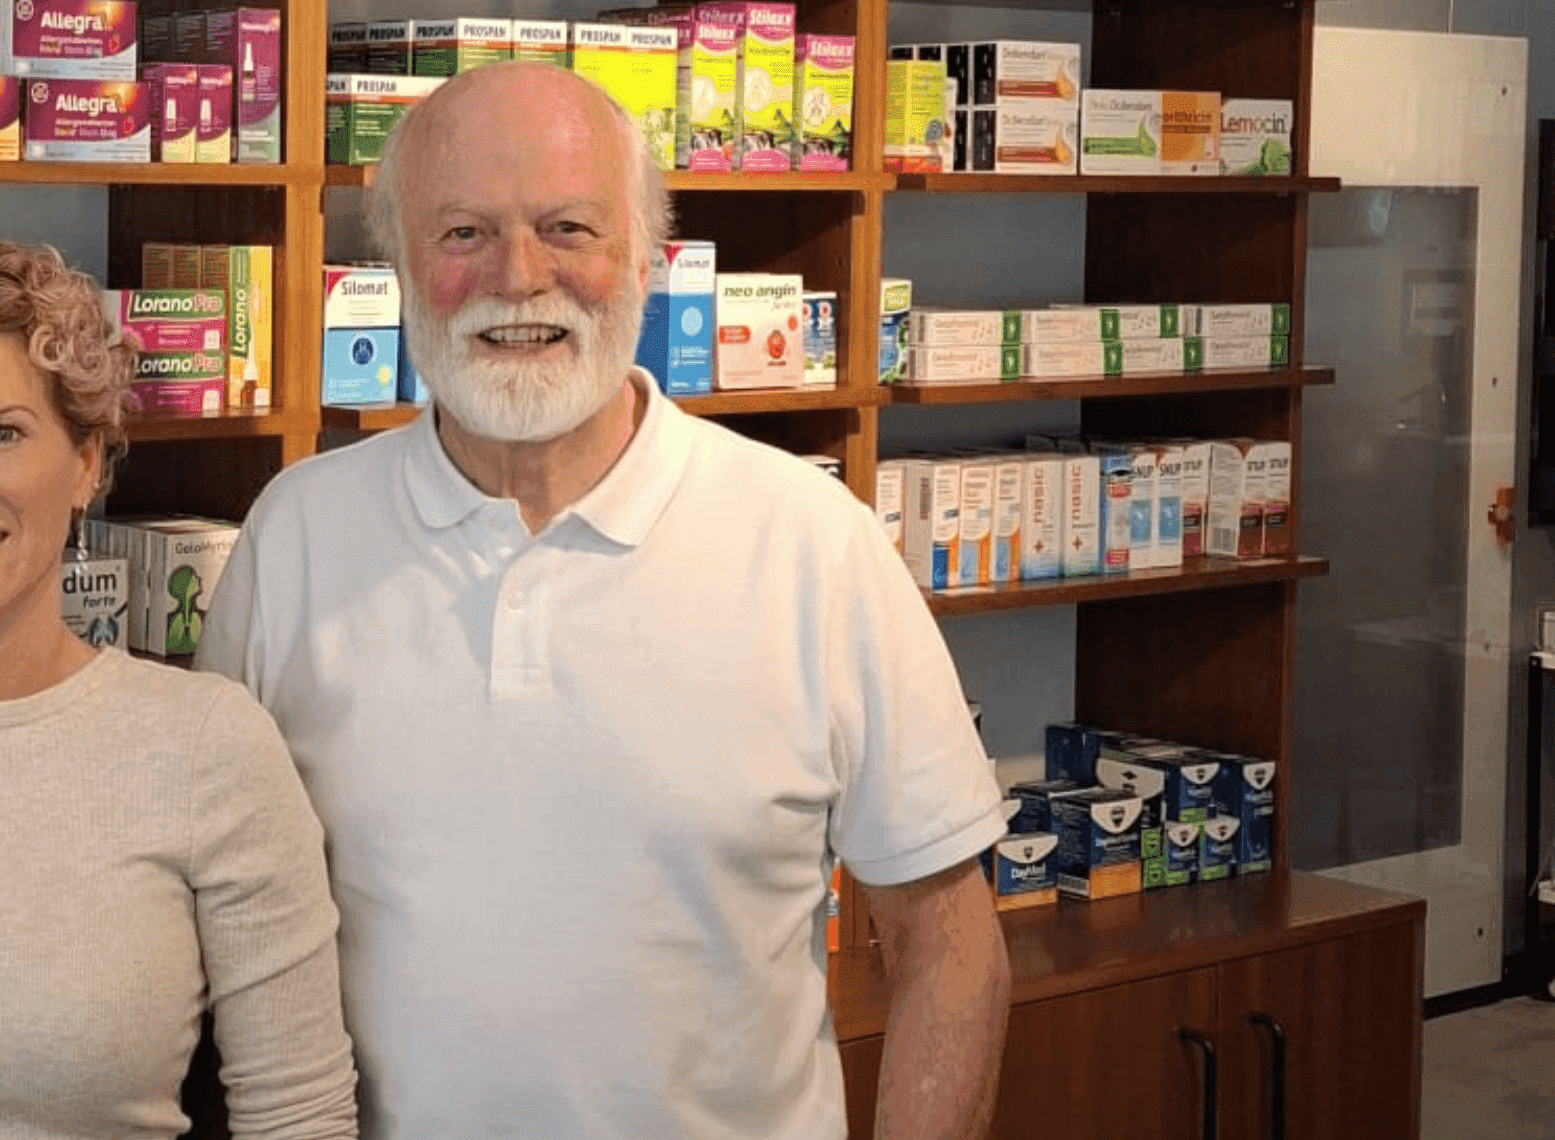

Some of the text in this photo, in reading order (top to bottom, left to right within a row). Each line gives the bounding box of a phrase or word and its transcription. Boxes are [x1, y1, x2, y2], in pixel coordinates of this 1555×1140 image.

[40, 12, 103, 34] Allegra
[463, 25, 507, 38] PROSPAN
[520, 27, 561, 41] PROSPAN
[580, 29, 621, 43] PROSPAN
[631, 32, 672, 46] PROSPAN
[357, 80, 397, 93] PROSPAN
[55, 94, 117, 117] Allegra
[1220, 112, 1287, 134] Lemocin
[340, 280, 388, 296] Silomat
[724, 283, 797, 300] neo angin
[233, 289, 247, 352] Lorano
[1033, 466, 1045, 524] nasic
[1071, 465, 1082, 521] nasic
[83, 595, 116, 608] forte
